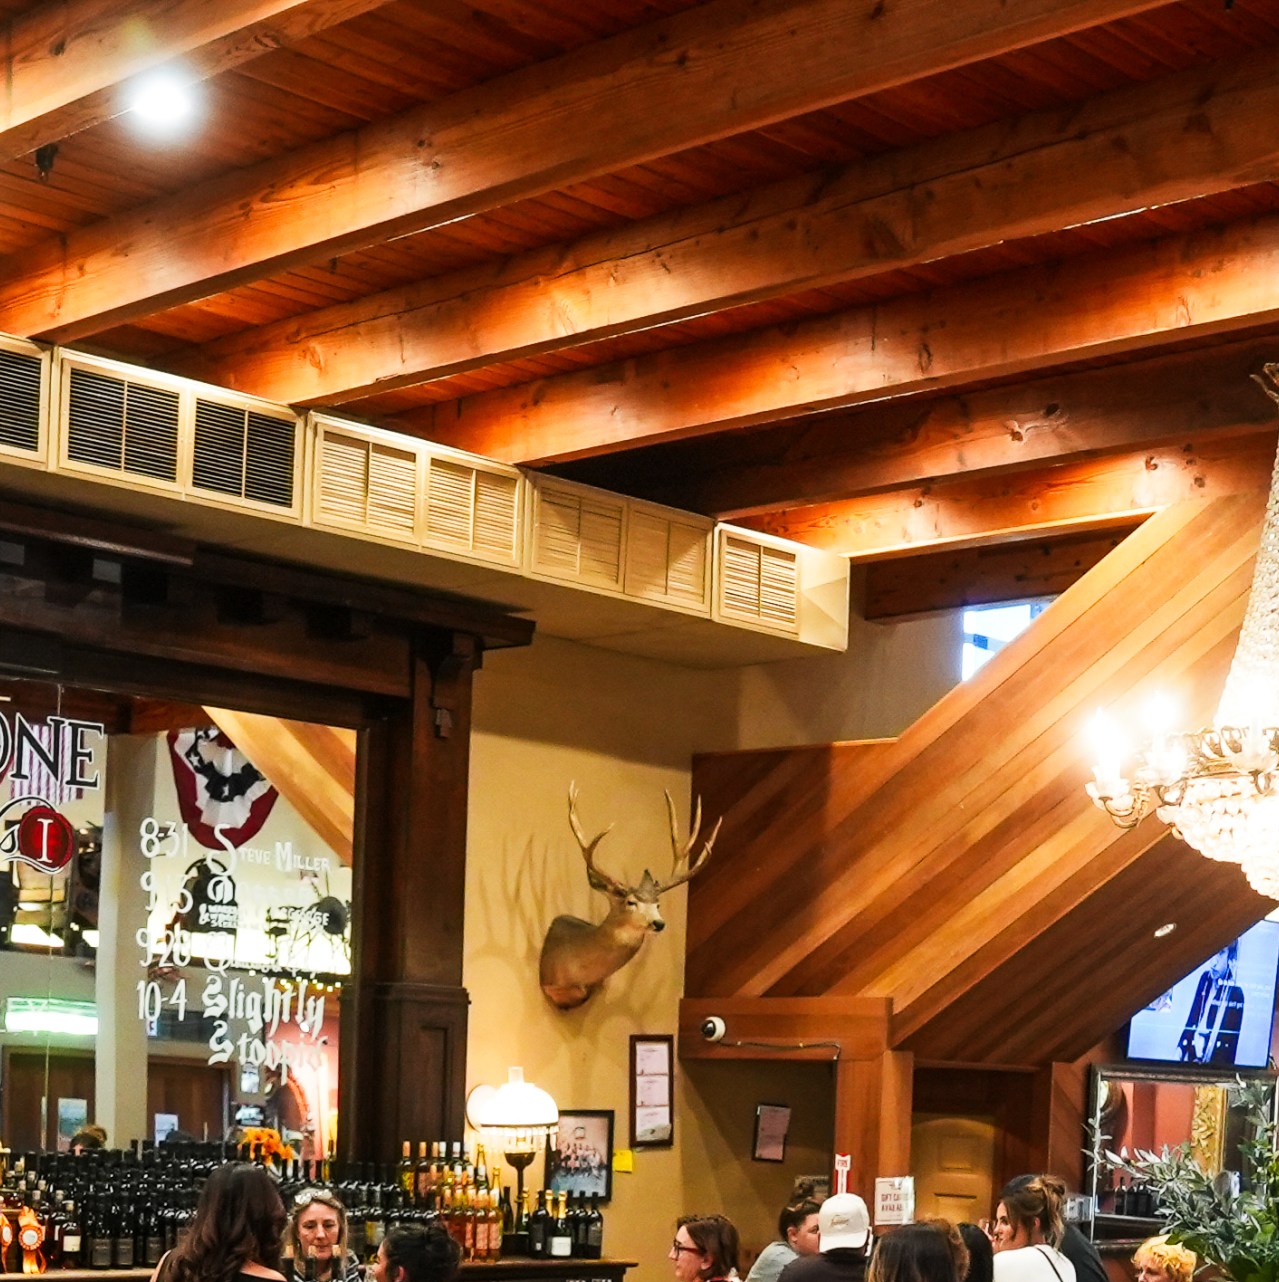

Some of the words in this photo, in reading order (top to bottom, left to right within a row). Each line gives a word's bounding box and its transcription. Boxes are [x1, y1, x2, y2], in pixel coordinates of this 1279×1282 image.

[206, 823, 271, 876] STEVE
[275, 841, 330, 872] MILLER
[136, 979, 187, 1021] 10-4
[201, 975, 325, 1041] Slightly
